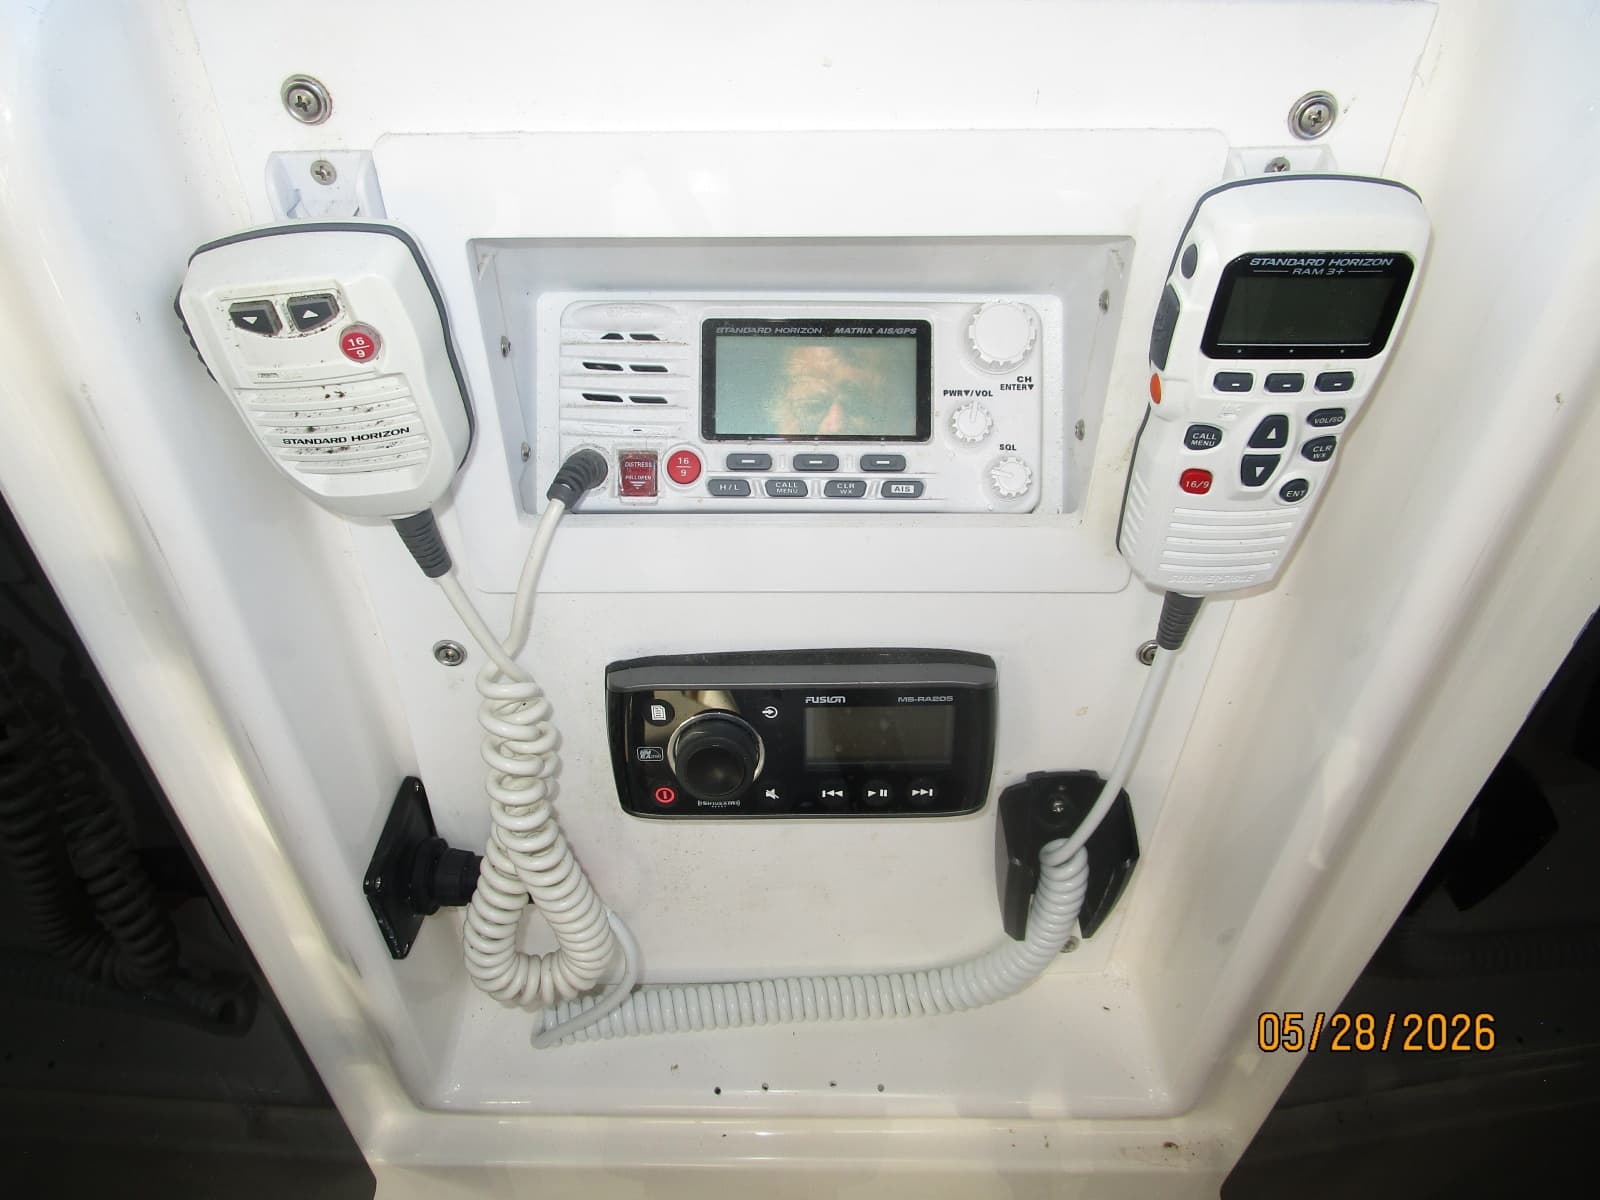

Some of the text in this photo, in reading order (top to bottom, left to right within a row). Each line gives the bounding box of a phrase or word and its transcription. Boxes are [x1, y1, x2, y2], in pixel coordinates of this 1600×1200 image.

[1250, 257, 1394, 266] STANDARD HORIZON
[348, 337, 365, 347] 16
[356, 350, 366, 358] 9
[282, 427, 410, 445] STANDARD HORIZON
[678, 457, 689, 465] 16
[805, 696, 846, 704] FUSION
